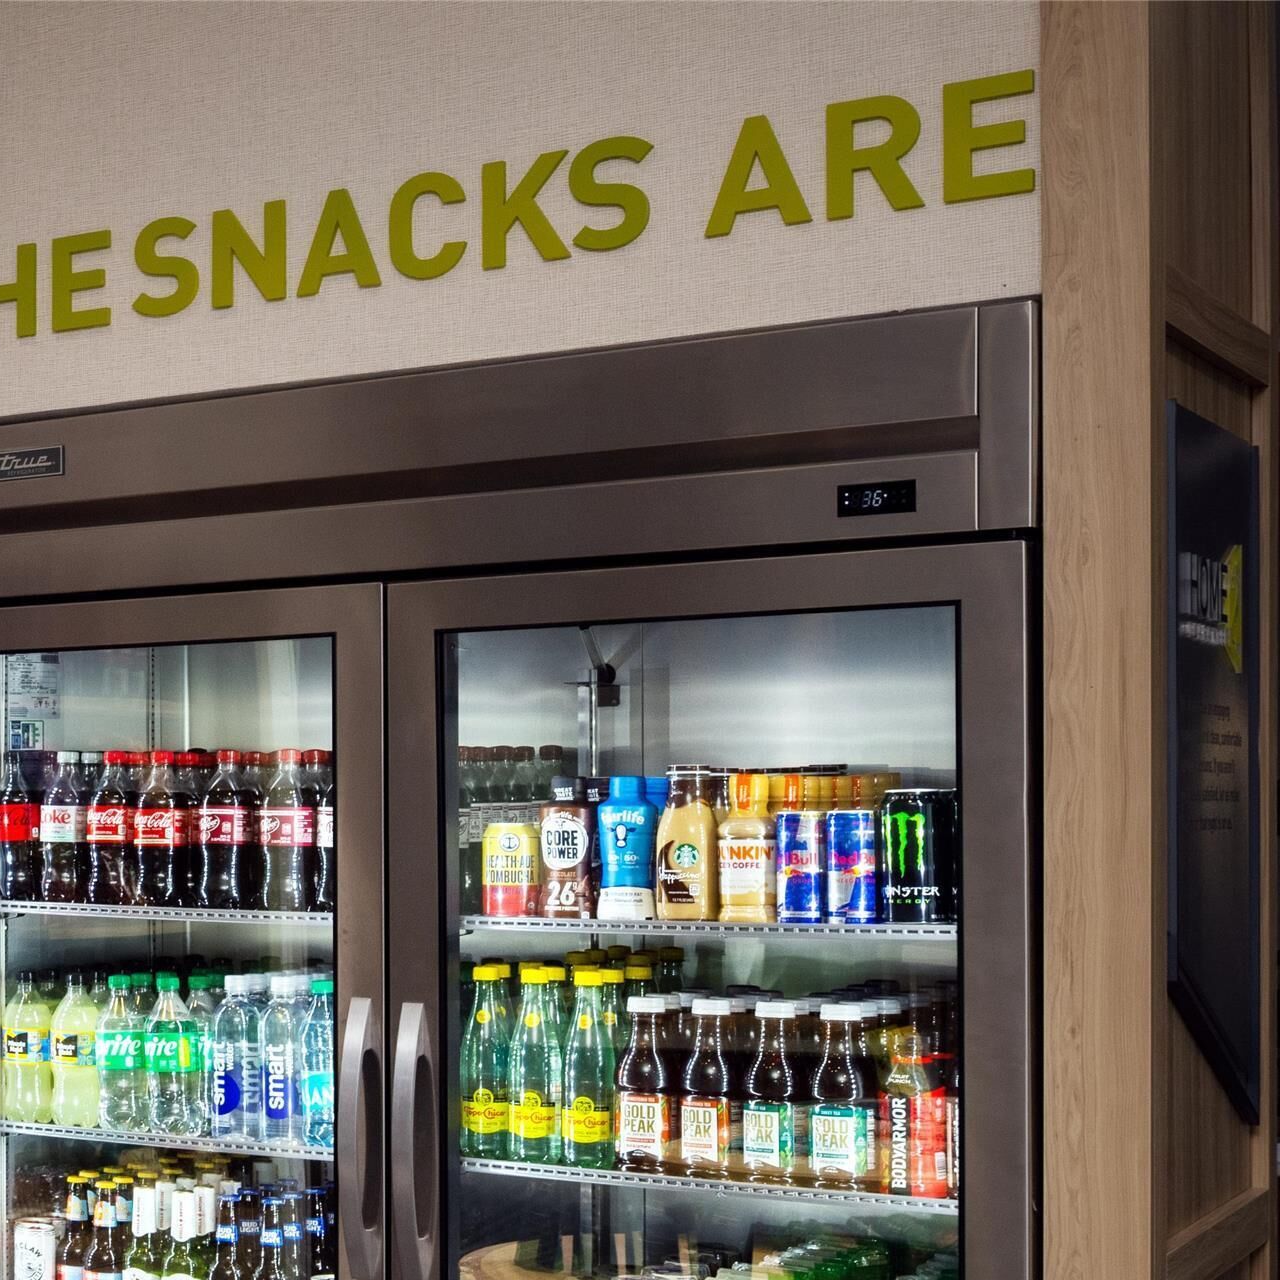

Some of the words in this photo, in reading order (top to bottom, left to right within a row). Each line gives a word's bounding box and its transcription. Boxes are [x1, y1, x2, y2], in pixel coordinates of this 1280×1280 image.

[130, 135, 654, 317] SNACKS
[704, 68, 1036, 239] ARE
[546, 830, 579, 847] CORE
[547, 847, 579, 860] POWER
[791, 852, 817, 866] Bull
[225, 1043, 234, 1071] water
[212, 1040, 226, 1106] smart
[268, 1043, 284, 1110] smart
[624, 1104, 656, 1119] GOLD
[683, 1109, 712, 1124] GOLD
[624, 1119, 655, 1134] PEAK
[891, 1097, 907, 1189] BODYARMOR
